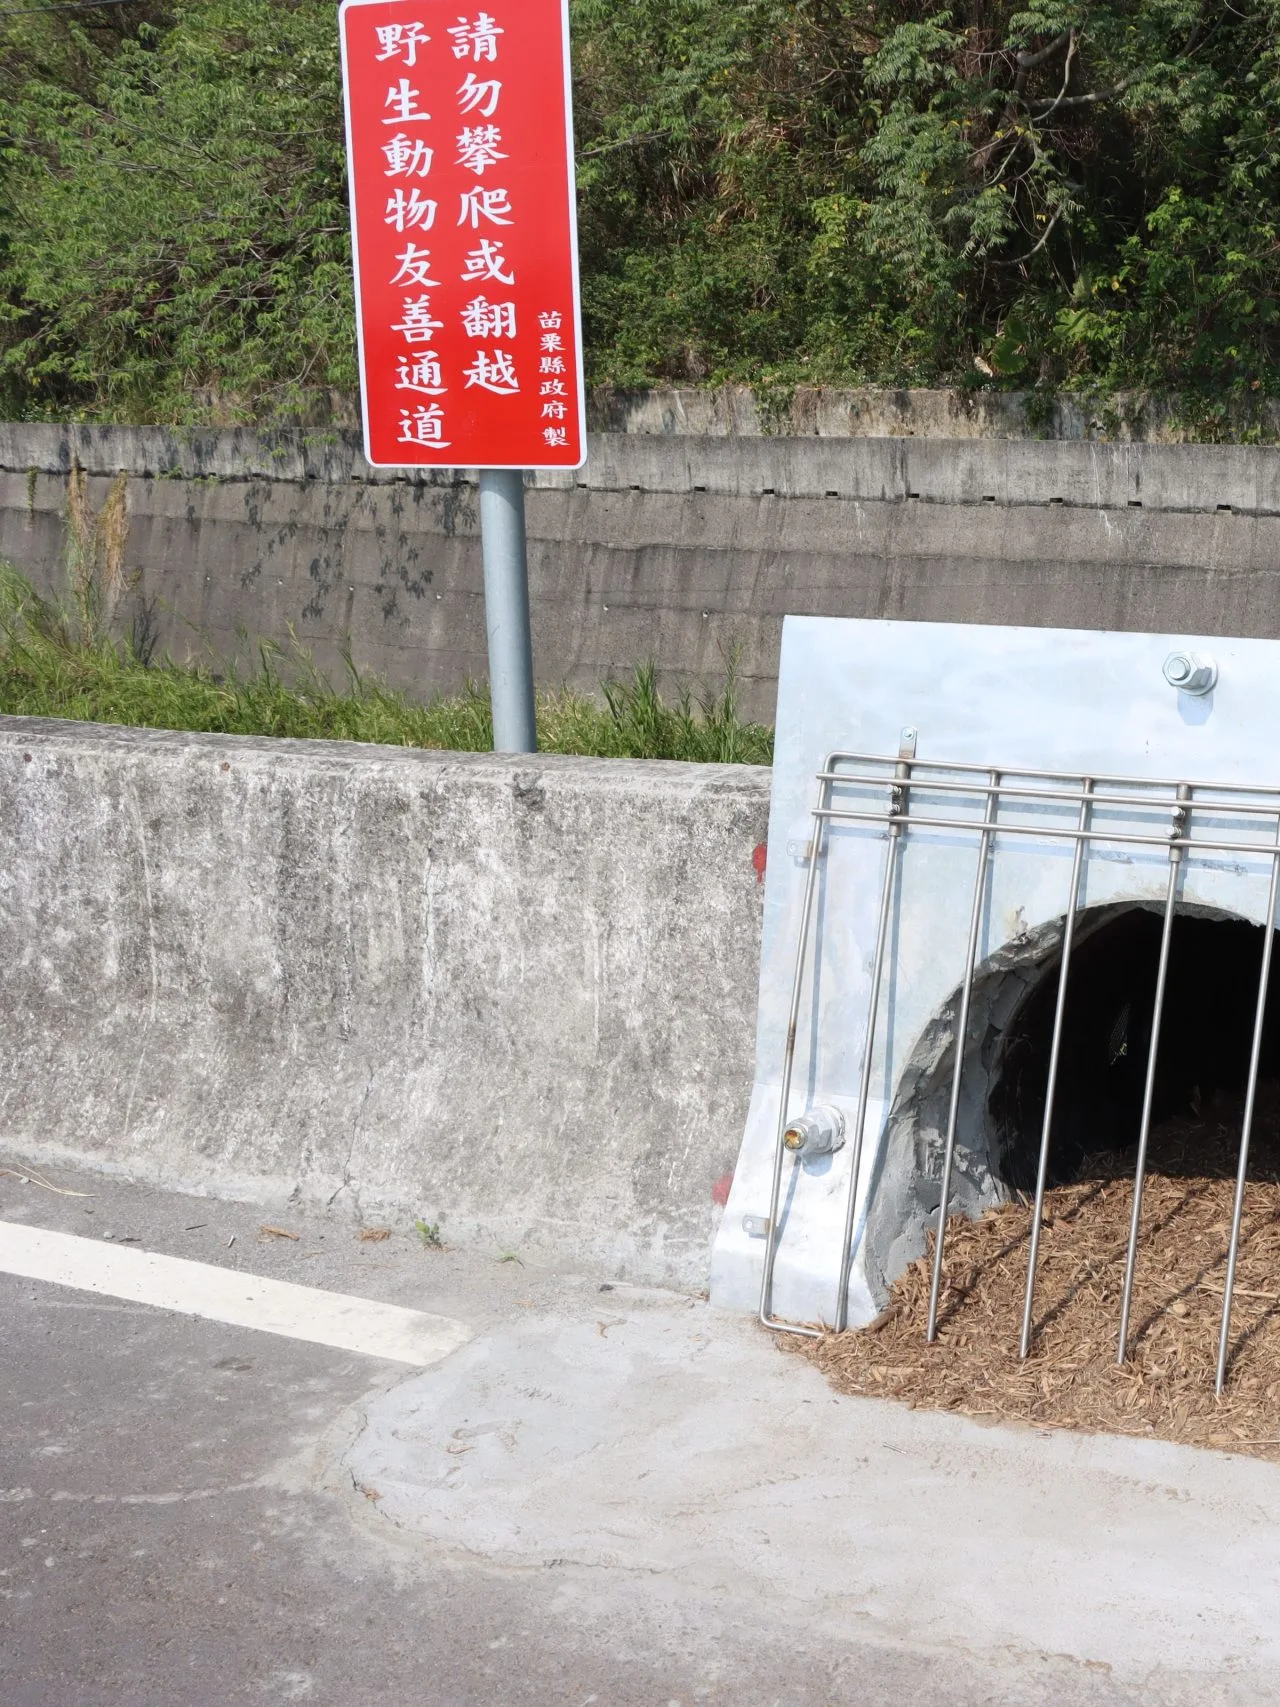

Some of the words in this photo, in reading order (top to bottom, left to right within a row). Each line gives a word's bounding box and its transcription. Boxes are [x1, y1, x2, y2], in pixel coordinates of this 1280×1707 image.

[375, 21, 452, 449] 野生動物友善通道
[446, 12, 521, 395] 請勿攀爬或翻越
[537, 310, 571, 448] 苗栗縣政府製
